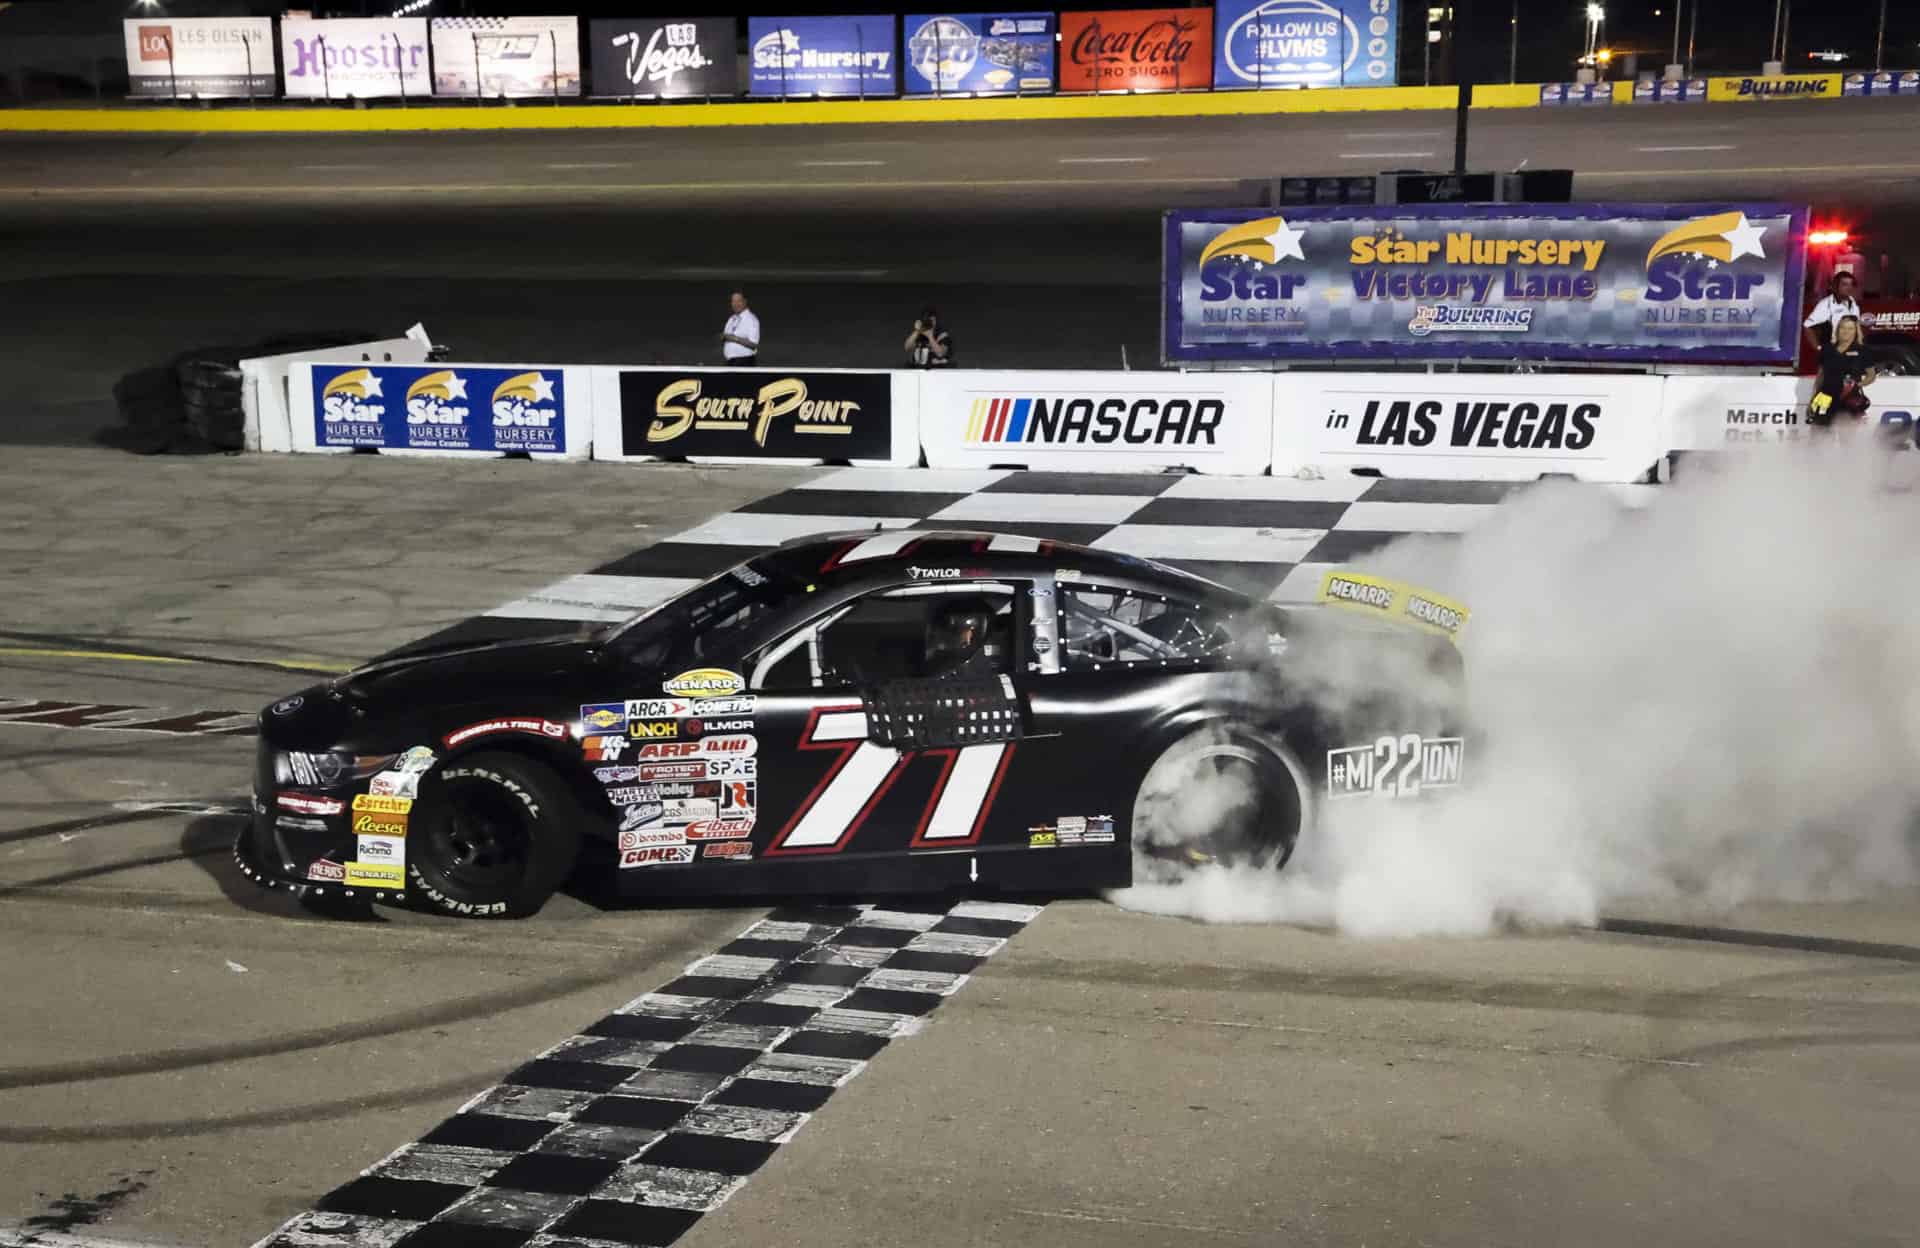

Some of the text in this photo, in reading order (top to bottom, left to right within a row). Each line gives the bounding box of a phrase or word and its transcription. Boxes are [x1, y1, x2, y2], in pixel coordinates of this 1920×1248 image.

[1246, 22, 1337, 39] FOLLOW US
[1256, 38, 1328, 59] #LVMS
[802, 49, 890, 70] Nursery
[1350, 232, 1605, 271] Star Nursery
[1200, 263, 1306, 302] Star
[1352, 269, 1598, 305] Victory Lane
[1644, 258, 1765, 302] Star
[1203, 307, 1302, 322] NURSERY
[1647, 307, 1758, 323] NURSERY
[323, 396, 386, 423] Star
[406, 398, 470, 425] Star
[492, 400, 557, 427] Star
[1726, 409, 1797, 425] March
[326, 424, 384, 436] NURSERY
[409, 426, 468, 438] NURSERY
[1026, 398, 1225, 445] NASCAR
[1325, 400, 1602, 451] in LAS VEGAS
[495, 429, 554, 441] NURSERY
[919, 568, 961, 578] TAYLOR
[1327, 577, 1395, 609] MENARDS
[1405, 594, 1463, 632] MENARDS
[667, 679, 743, 691] MENARDS
[628, 702, 668, 717] ARCA
[630, 721, 678, 737] UNOH
[704, 720, 755, 731] ILMOR
[640, 743, 701, 759] ARP
[763, 703, 1017, 856] 77
[441, 767, 540, 819] GENERAL
[409, 863, 506, 915] GENERAL
